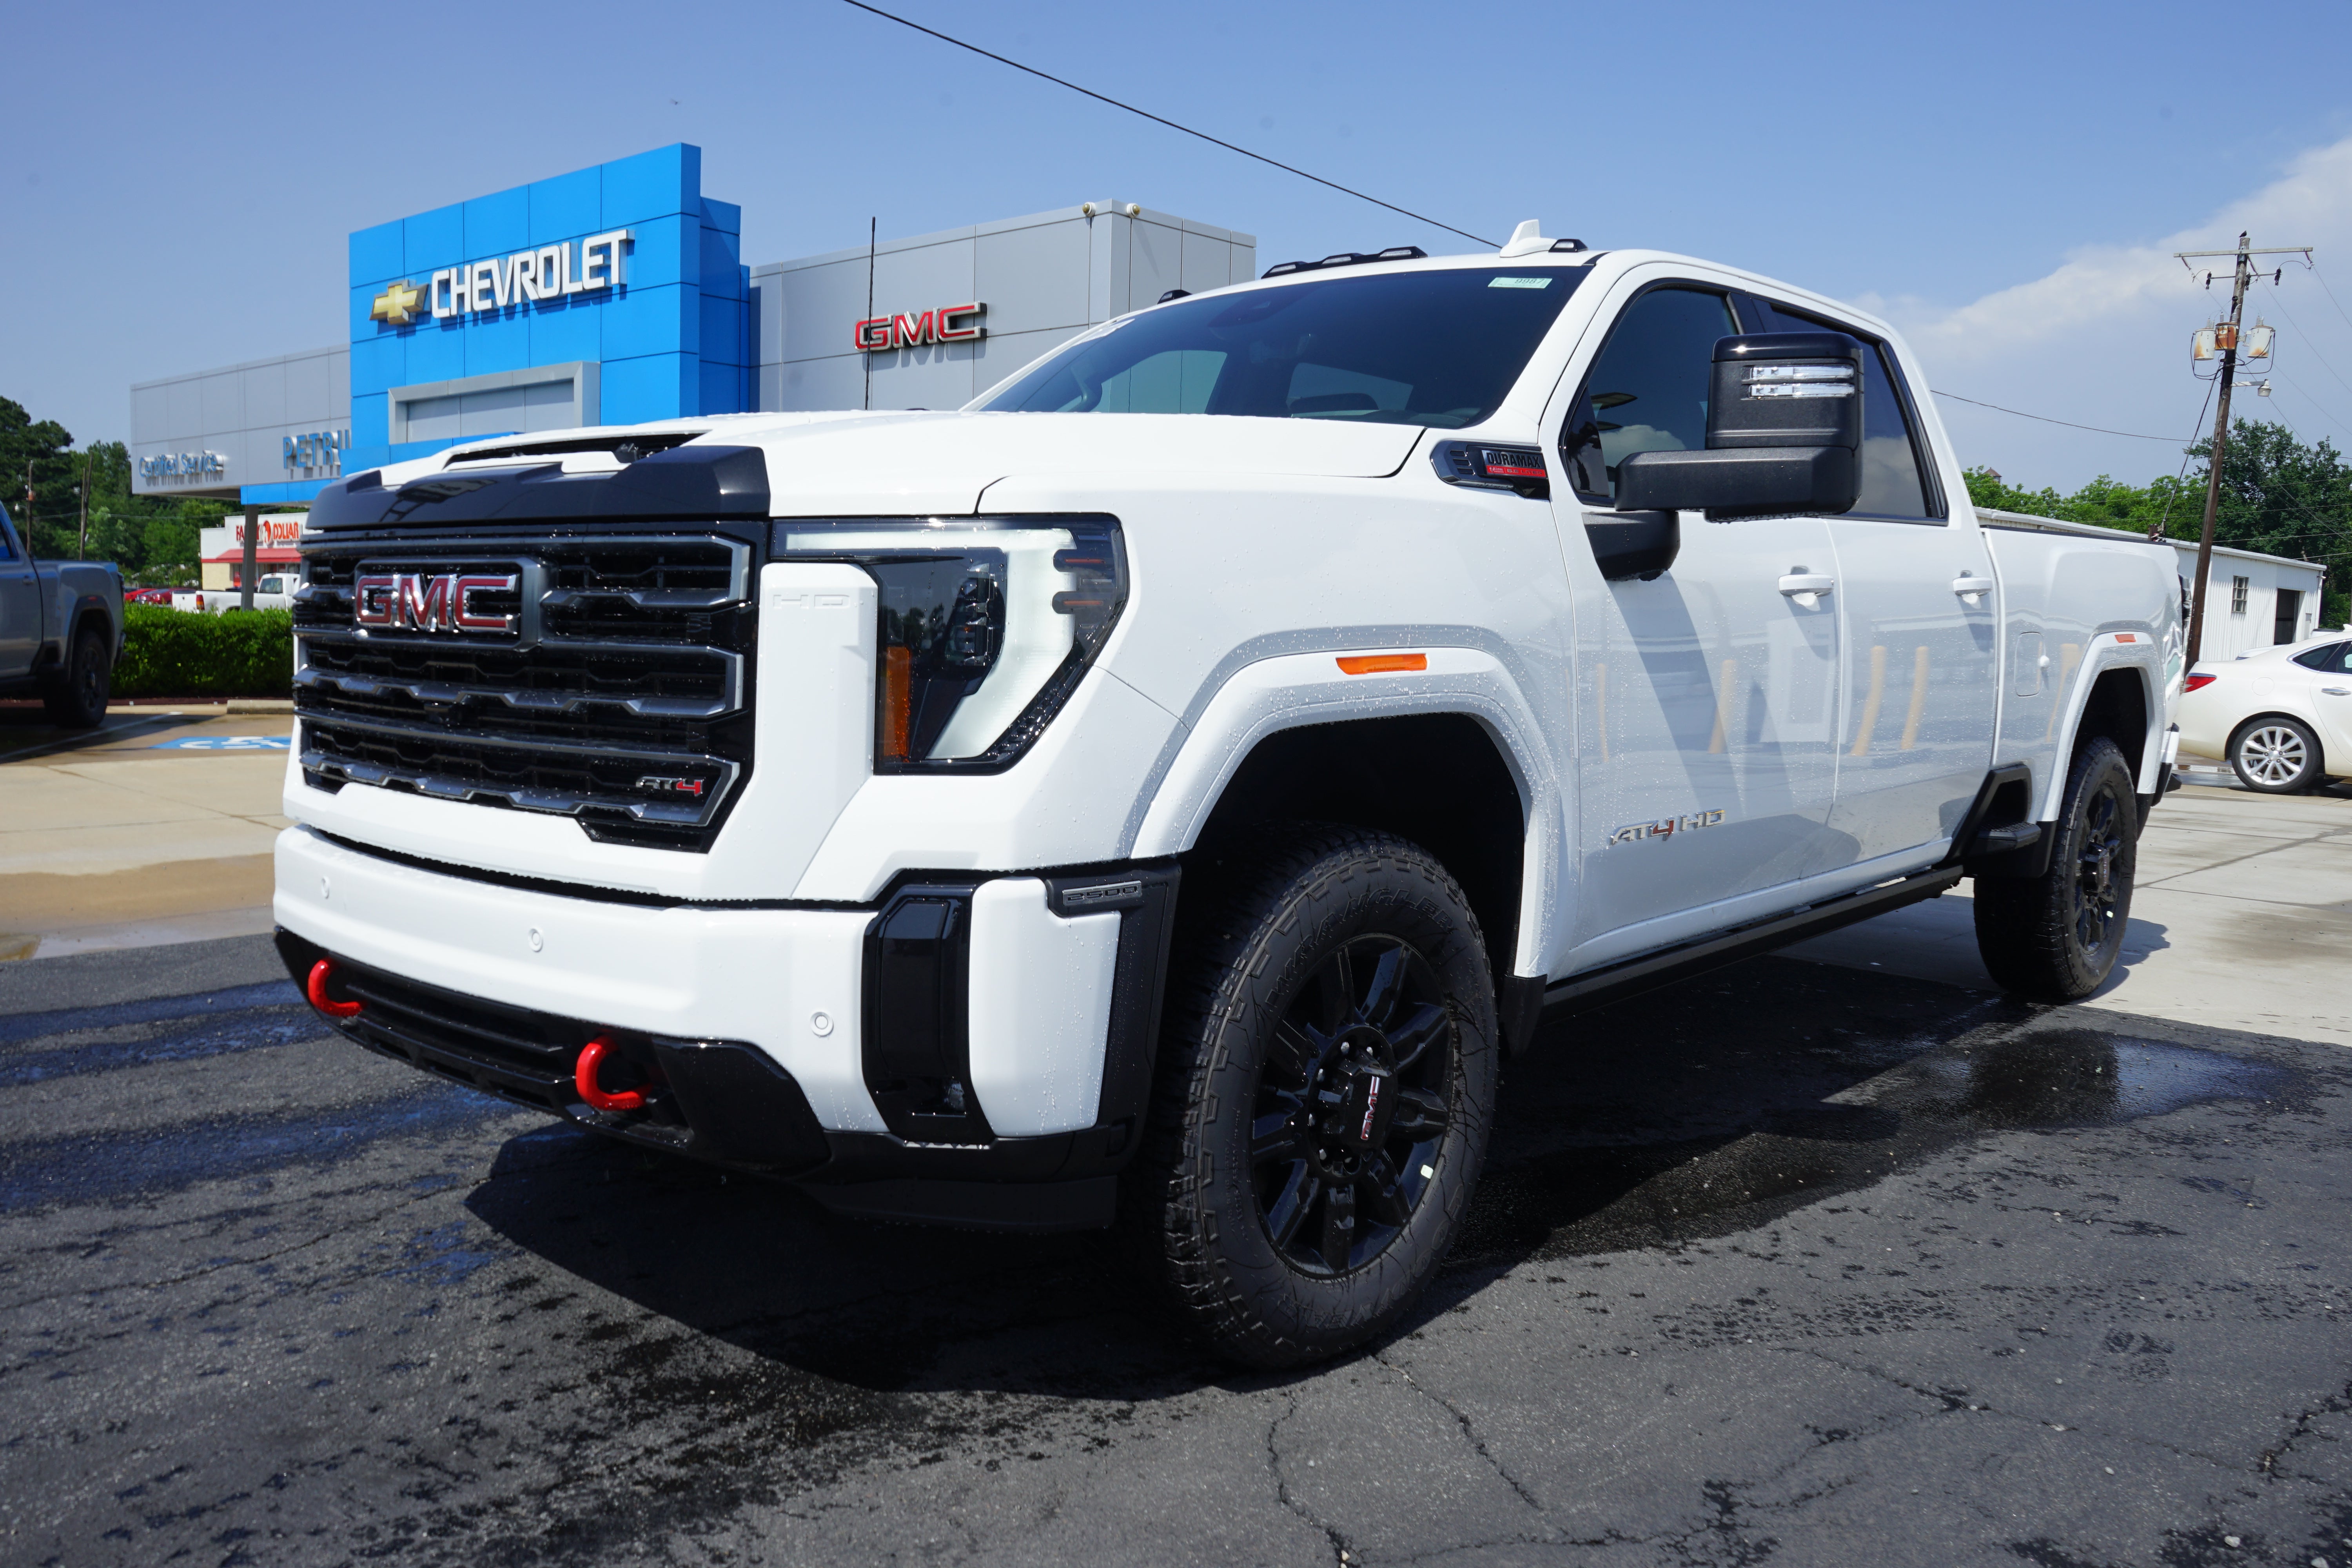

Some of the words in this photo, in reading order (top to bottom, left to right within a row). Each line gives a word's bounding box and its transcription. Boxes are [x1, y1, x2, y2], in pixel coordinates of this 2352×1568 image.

[432, 229, 629, 319] CHEVROLET
[853, 301, 982, 352] GMC
[139, 453, 178, 477] Certified
[181, 450, 219, 475] Service
[1486, 452, 1541, 468] DURAMAX
[273, 521, 299, 540] DOLLAR
[356, 574, 516, 631] GMC
[773, 594, 851, 609] HD
[635, 776, 703, 797] AT4
[1608, 816, 1675, 845] AT4
[1680, 808, 1725, 832] HD
[1066, 886, 1138, 902] 2500
[1265, 887, 1453, 1010] WRANGLER
[1360, 1075, 1381, 1141] GMC
